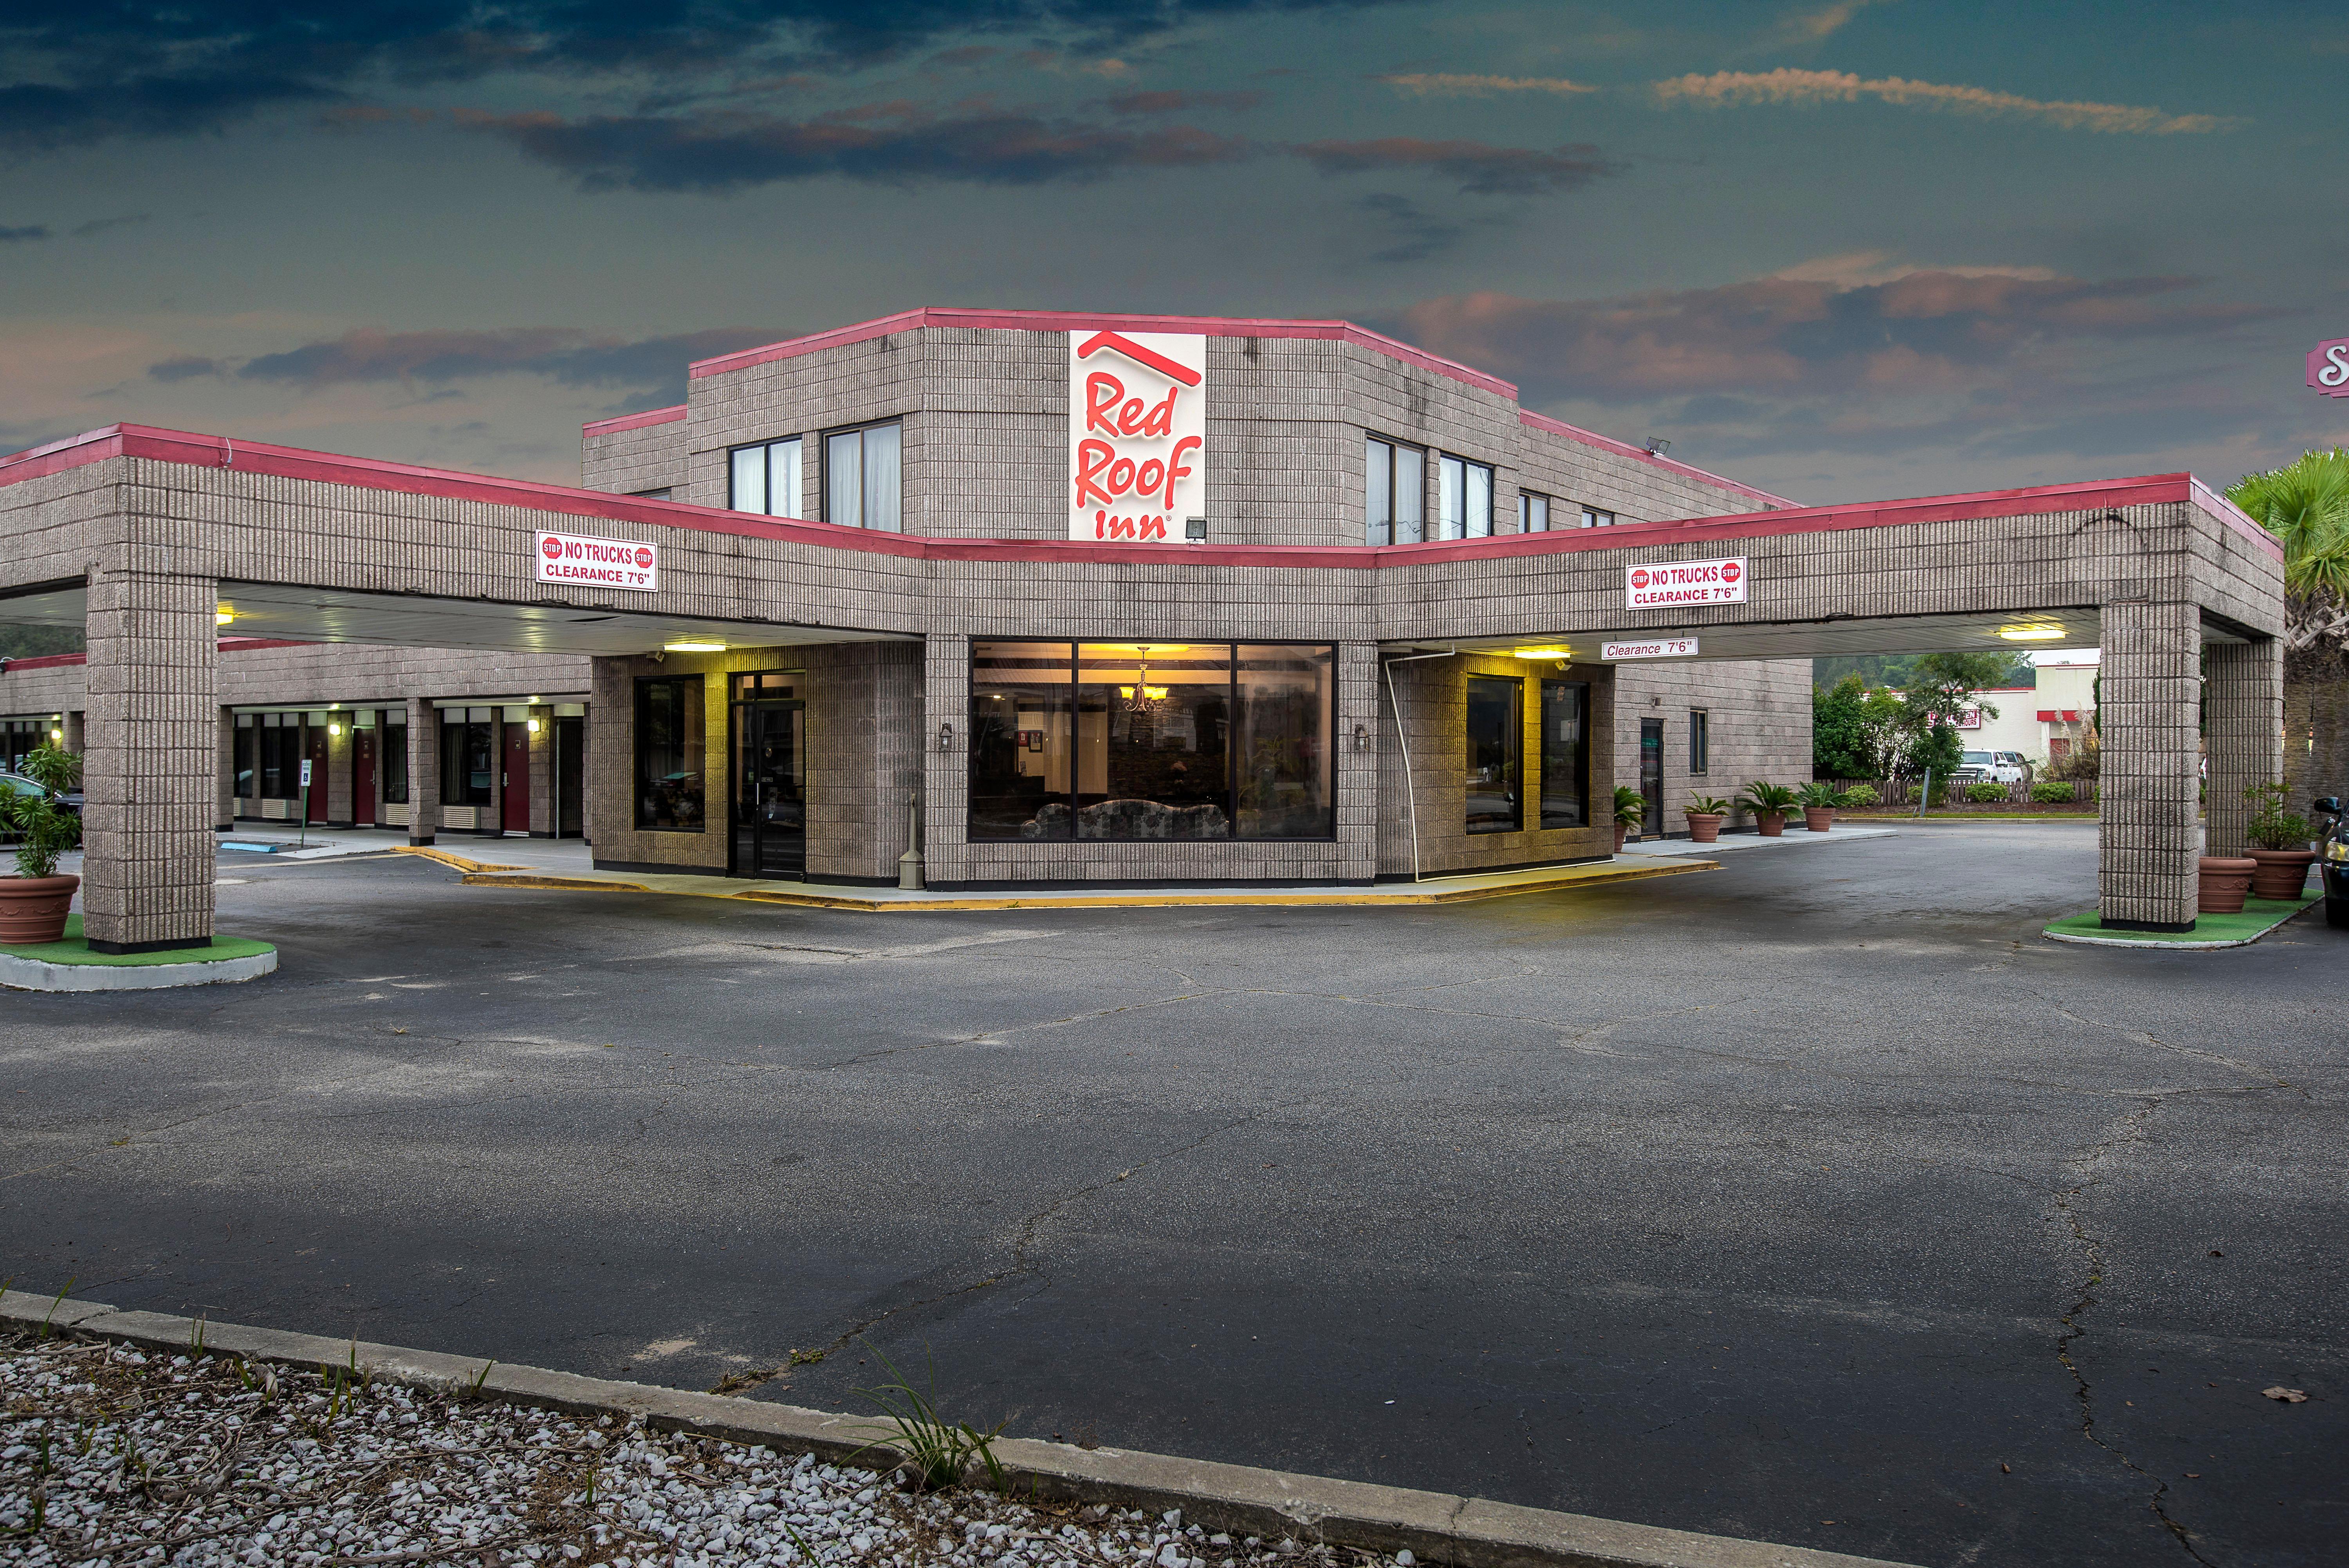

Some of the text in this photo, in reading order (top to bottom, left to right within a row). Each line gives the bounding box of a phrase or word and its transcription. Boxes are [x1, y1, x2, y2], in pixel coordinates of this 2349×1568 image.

[1086, 372, 1178, 437] Red
[1075, 436, 1202, 510] Roof
[1096, 510, 1167, 540] Inn
[543, 541, 652, 564] STOP NO TRUCKS STOP
[546, 564, 649, 584] CLEARANCE 7'6"
[1632, 566, 1740, 585] STOP NO TRUCKS STOP
[1635, 587, 1737, 604] CLEARANCE 7'6"
[1607, 641, 1692, 656] Clearance 7'6"
